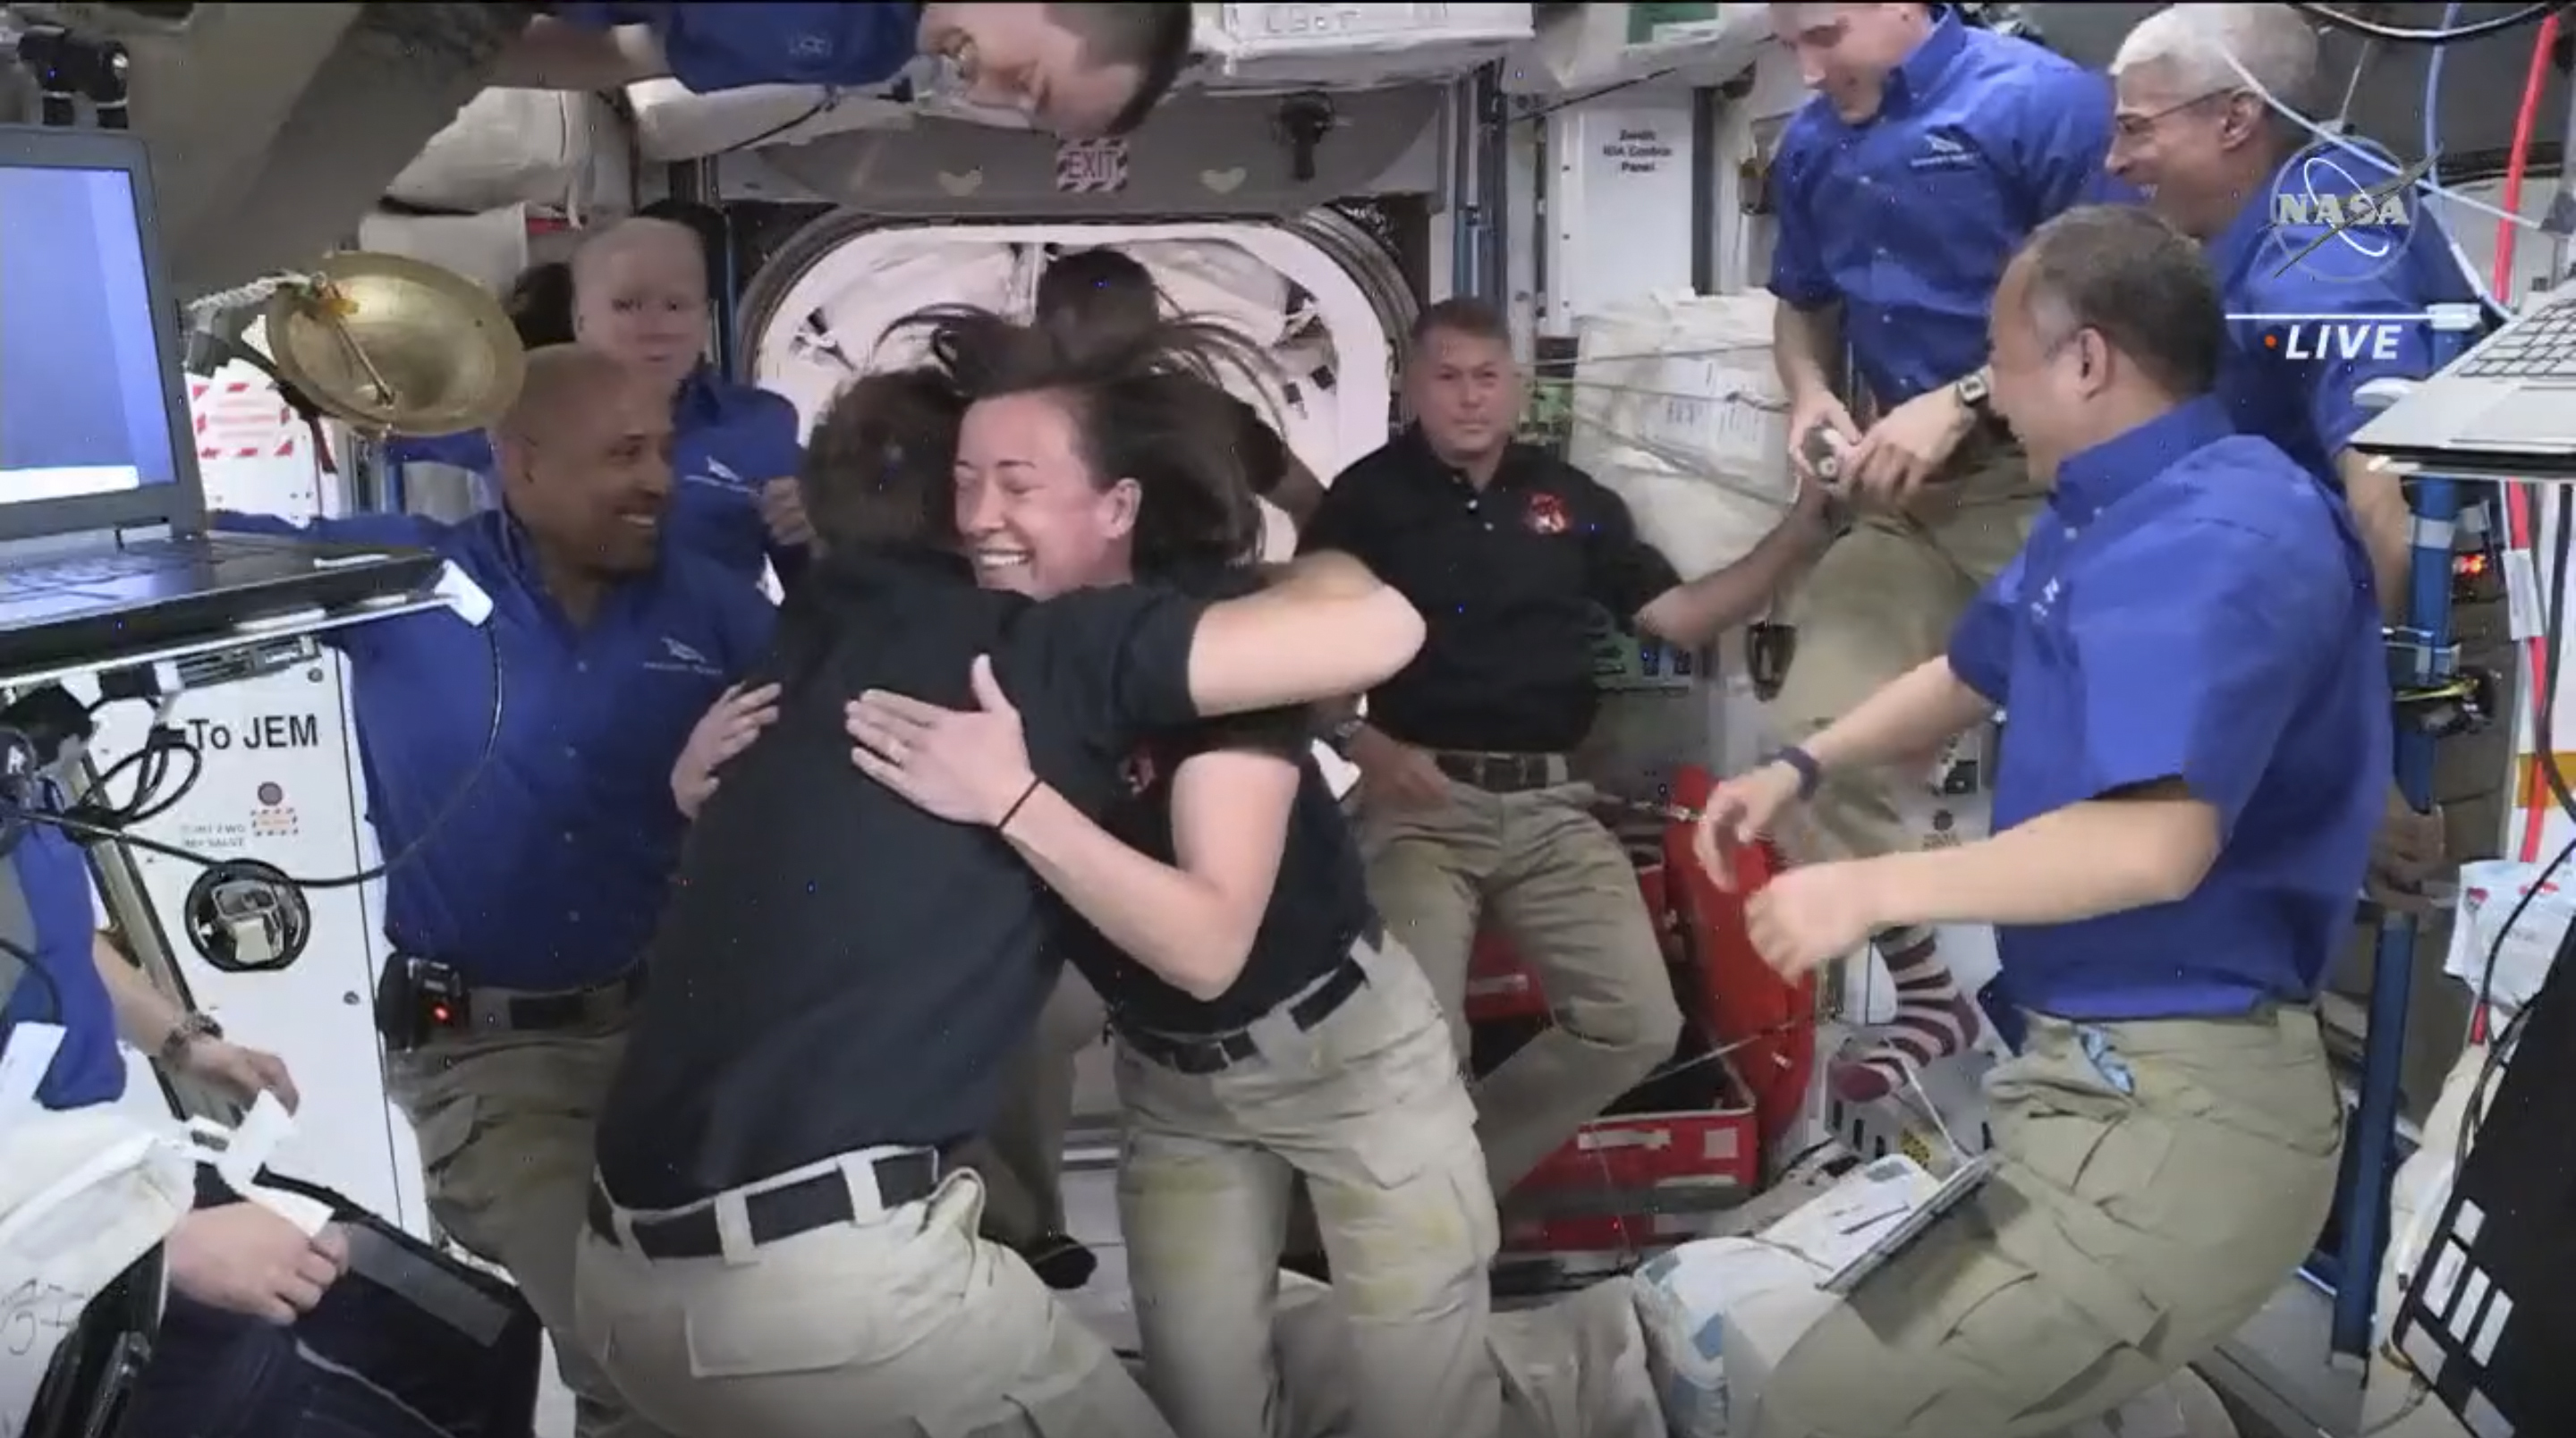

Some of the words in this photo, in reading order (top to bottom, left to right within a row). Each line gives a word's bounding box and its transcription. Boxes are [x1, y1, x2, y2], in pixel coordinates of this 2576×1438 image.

[1066, 149, 1118, 179] EXIT
[187, 718, 231, 749] To
[243, 714, 318, 749] JEM
